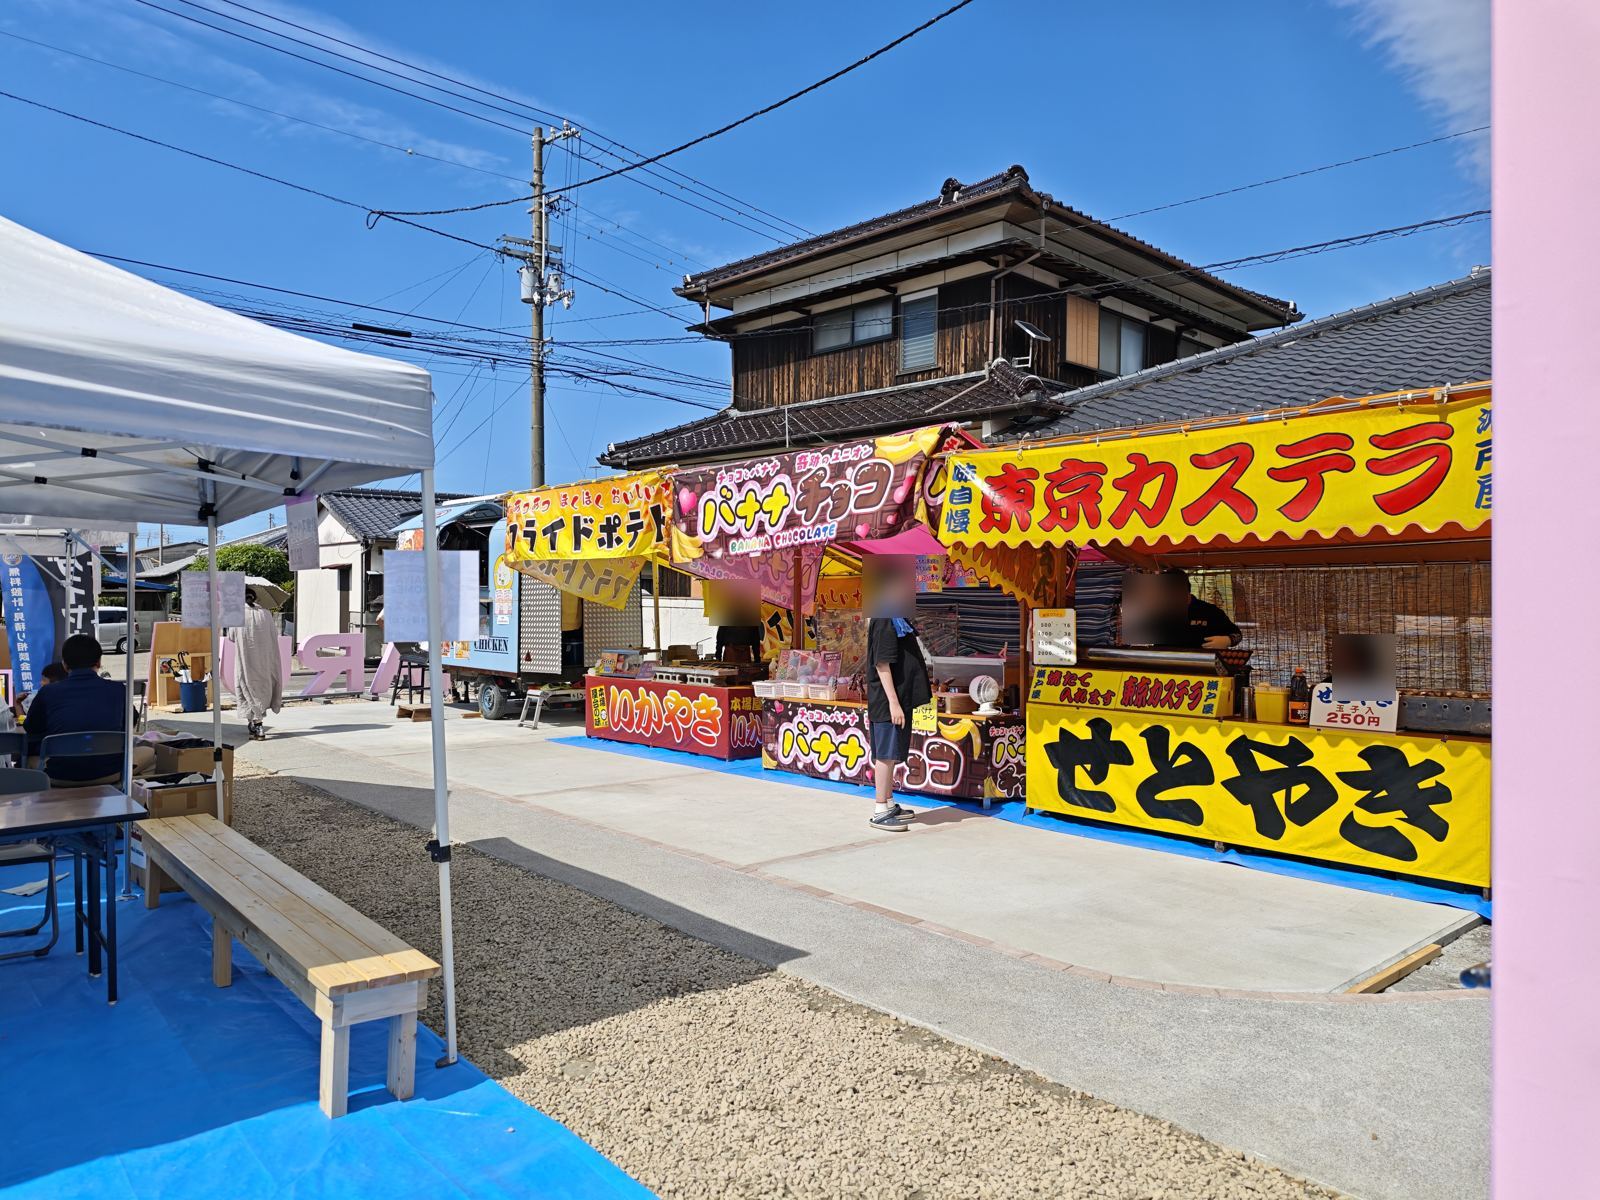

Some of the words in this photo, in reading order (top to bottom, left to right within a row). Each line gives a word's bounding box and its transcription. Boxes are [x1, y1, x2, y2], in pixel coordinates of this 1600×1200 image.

[716, 461, 781, 485] チョコとバナナ
[979, 421, 1455, 535] 東京カステラ
[700, 481, 791, 536] バナナ
[795, 458, 895, 525] チョコ
[730, 536, 771, 554] BANANA
[774, 521, 838, 547] CHOCOLATE
[474, 637, 509, 652] CHICKEN
[1046, 669, 1093, 688] 焼たて
[1120, 675, 1204, 711] 東京カステラ
[1202, 680, 1219, 715] 瀬戸屋
[1336, 704, 1375, 715] 玉子入
[609, 684, 723, 748] いかやき
[797, 706, 859, 726] チョコとバナナ
[1326, 712, 1380, 727] 250円
[781, 721, 865, 771] バナナ
[1043, 716, 1453, 862] せとやき
